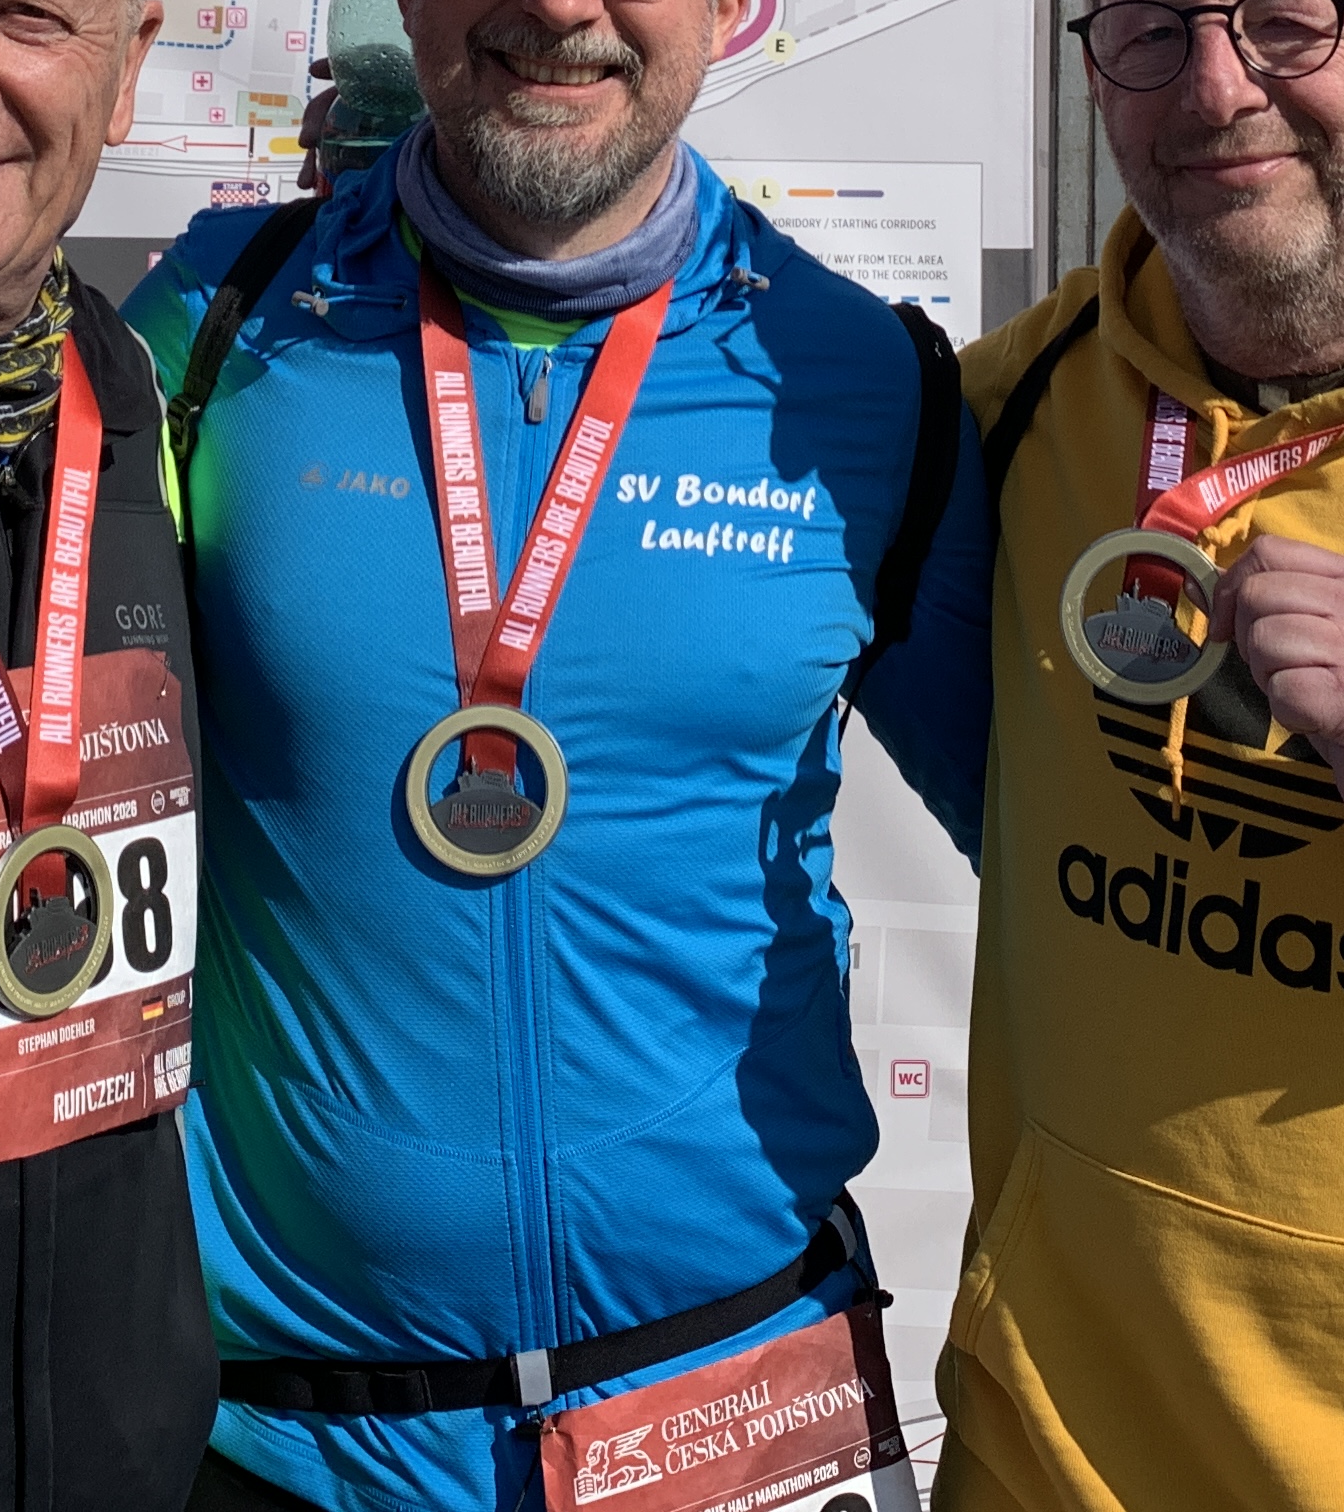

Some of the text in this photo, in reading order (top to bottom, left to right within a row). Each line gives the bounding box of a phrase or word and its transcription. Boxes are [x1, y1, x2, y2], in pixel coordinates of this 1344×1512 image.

[775, 38, 786, 53] E
[762, 184, 771, 199] L
[771, 217, 937, 230] KORIDORY STARTING CORRIDORS
[834, 254, 855, 265] WAY
[858, 254, 885, 265] FROM
[888, 255, 915, 266] TECH.
[918, 255, 944, 266] AREA
[858, 270, 869, 281] TO
[871, 270, 888, 281] THE
[891, 270, 948, 281] CORRIDORS
[336, 469, 411, 501] JAKO
[434, 371, 492, 617] ALL RUNNERS ARE BEAUTIFUL
[616, 472, 818, 521] SV Bondorf
[1198, 473, 1227, 515] ALL
[1224, 445, 1303, 498] RUNNERS
[498, 414, 615, 653] ALL RUNNERS ARE BEAUTIFUL
[642, 519, 794, 564] Lauftreff
[39, 467, 92, 745] ALL RUNNERS ARE BEAUTIFUL
[115, 603, 166, 630] GORE
[113, 799, 138, 823] 2026
[17, 1017, 96, 1056] STEPHAN DOEHLER
[53, 1070, 135, 1124] RUNCZECH
[898, 1072, 924, 1086] WC
[660, 1378, 772, 1443] GENERALI
[663, 1376, 876, 1475] ČESKÁ POJIŠŤOVNA
[754, 1469, 813, 1509] MARATHON
[813, 1461, 840, 1485] 2026
